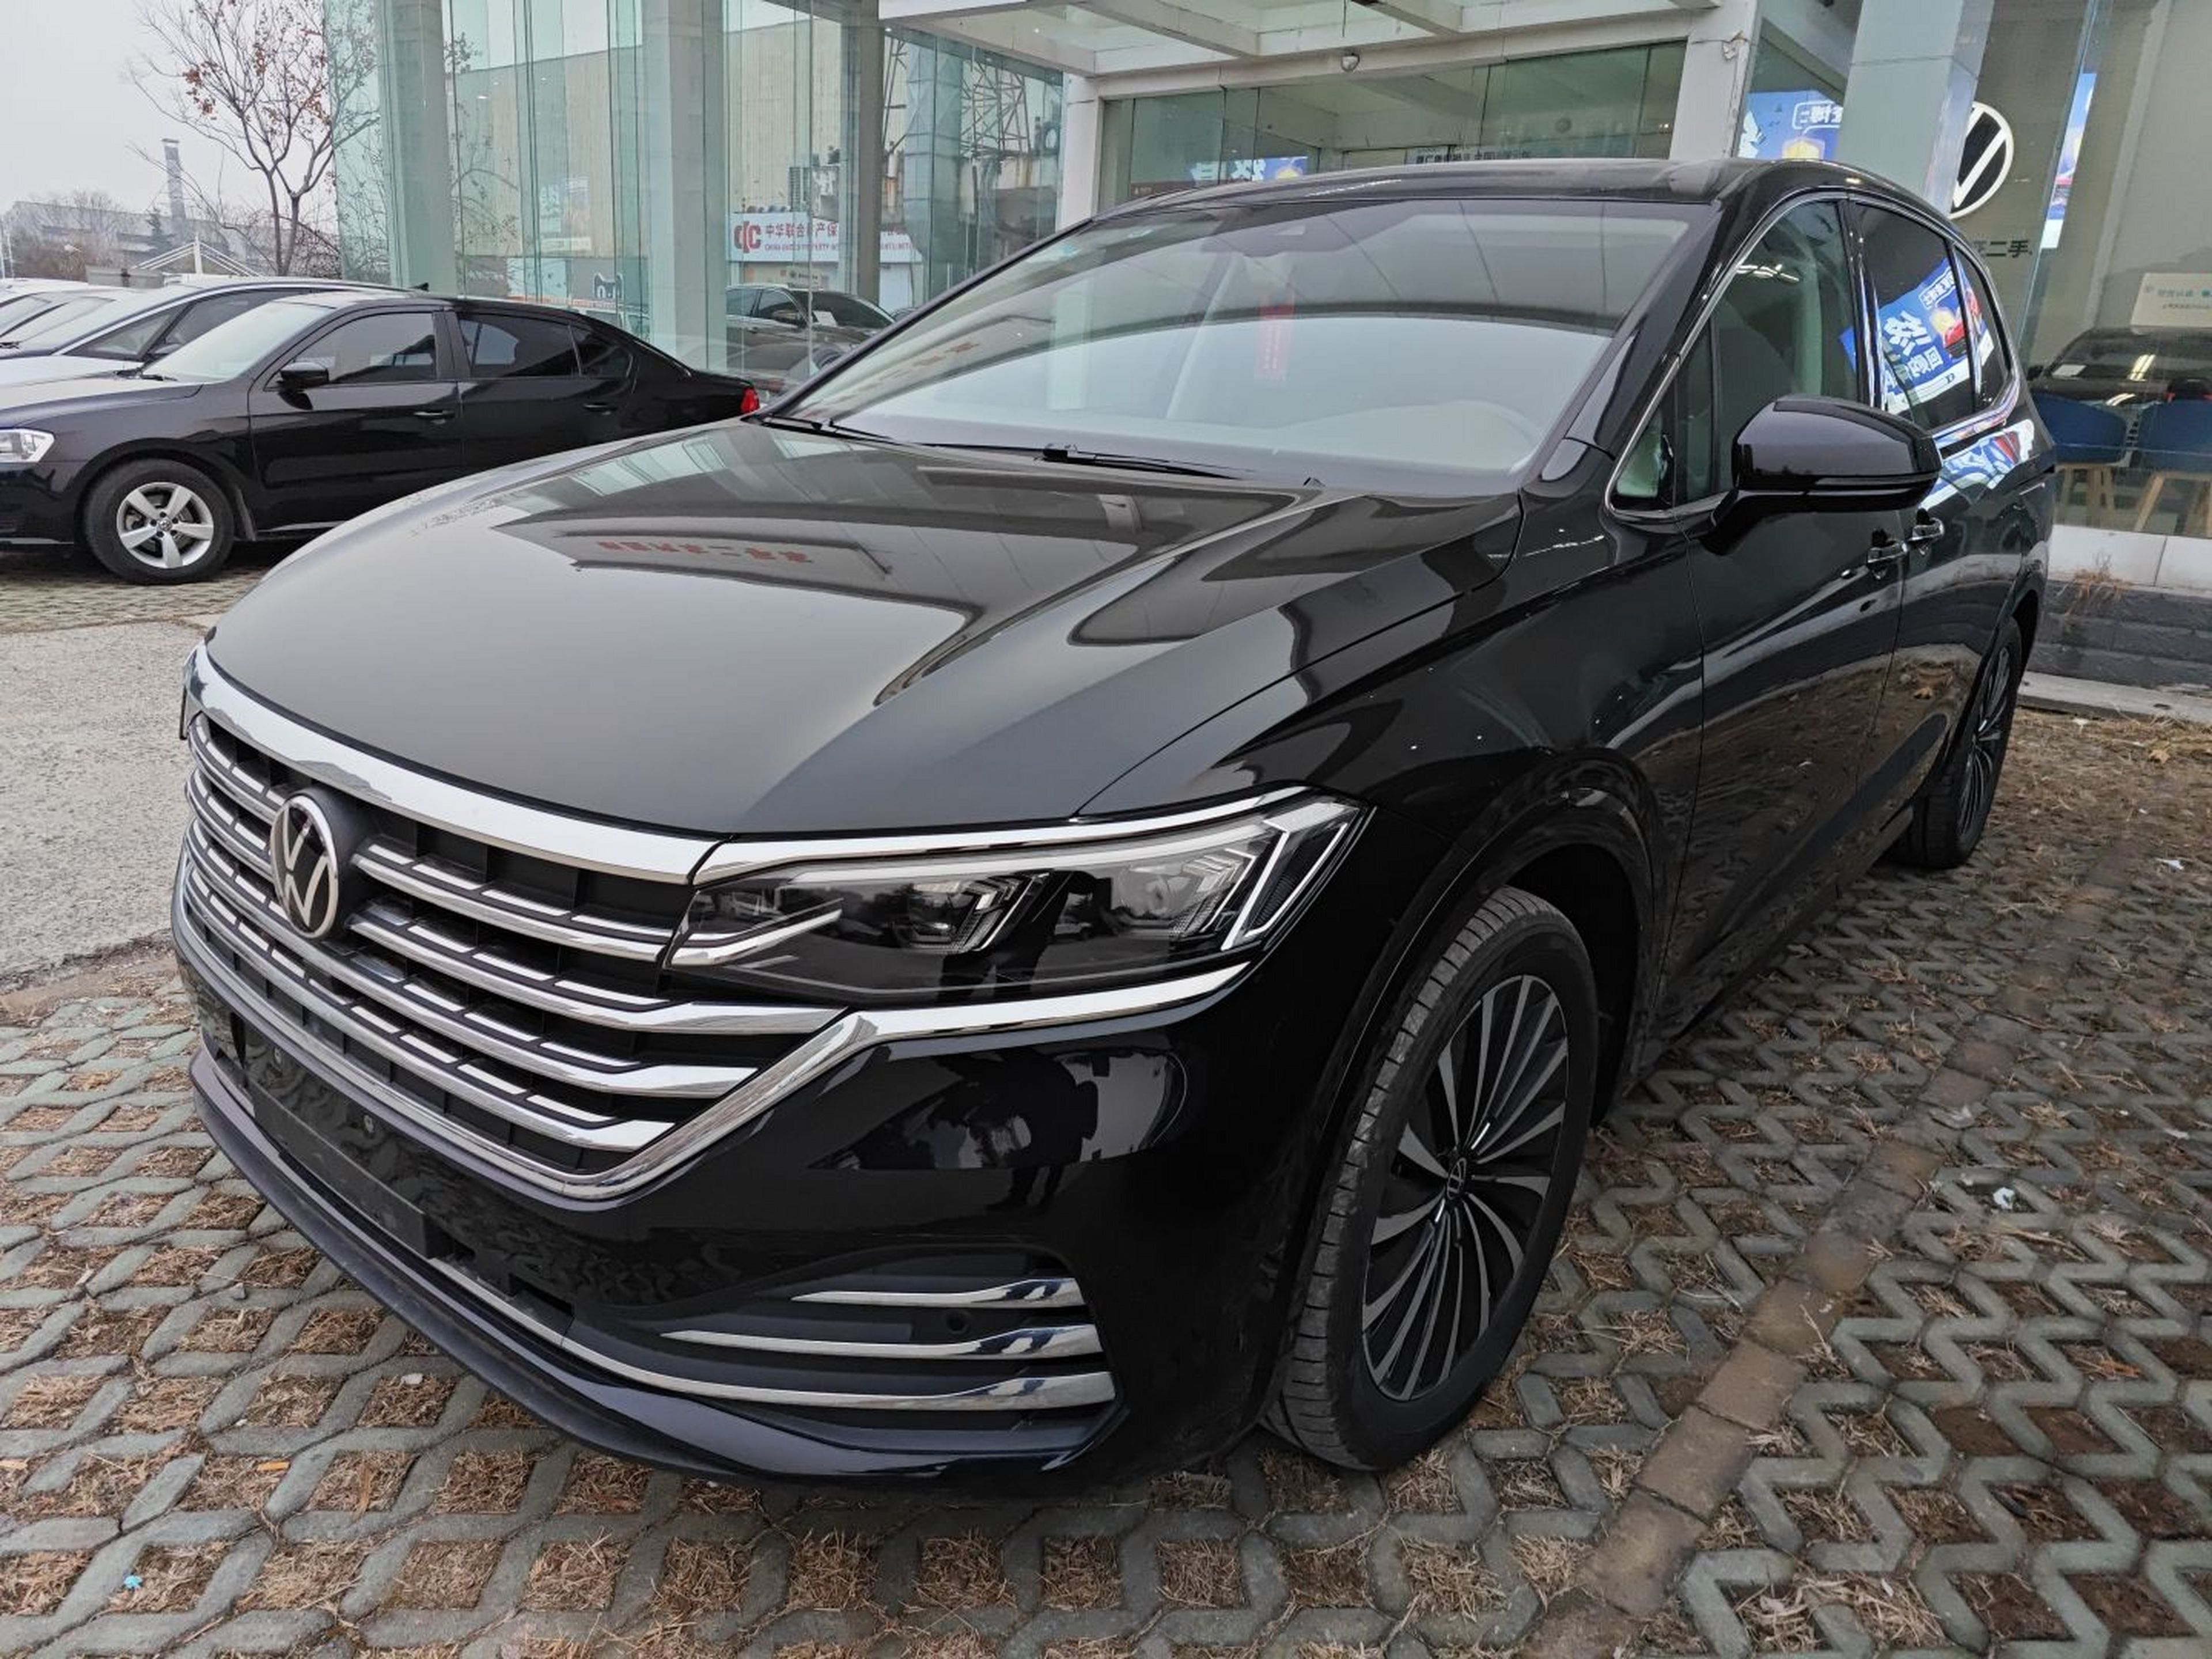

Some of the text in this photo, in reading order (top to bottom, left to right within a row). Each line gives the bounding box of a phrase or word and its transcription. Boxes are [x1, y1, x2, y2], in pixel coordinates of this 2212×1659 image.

[766, 222, 838, 238] 中华联合产保
[1973, 240, 2033, 258] 二手
